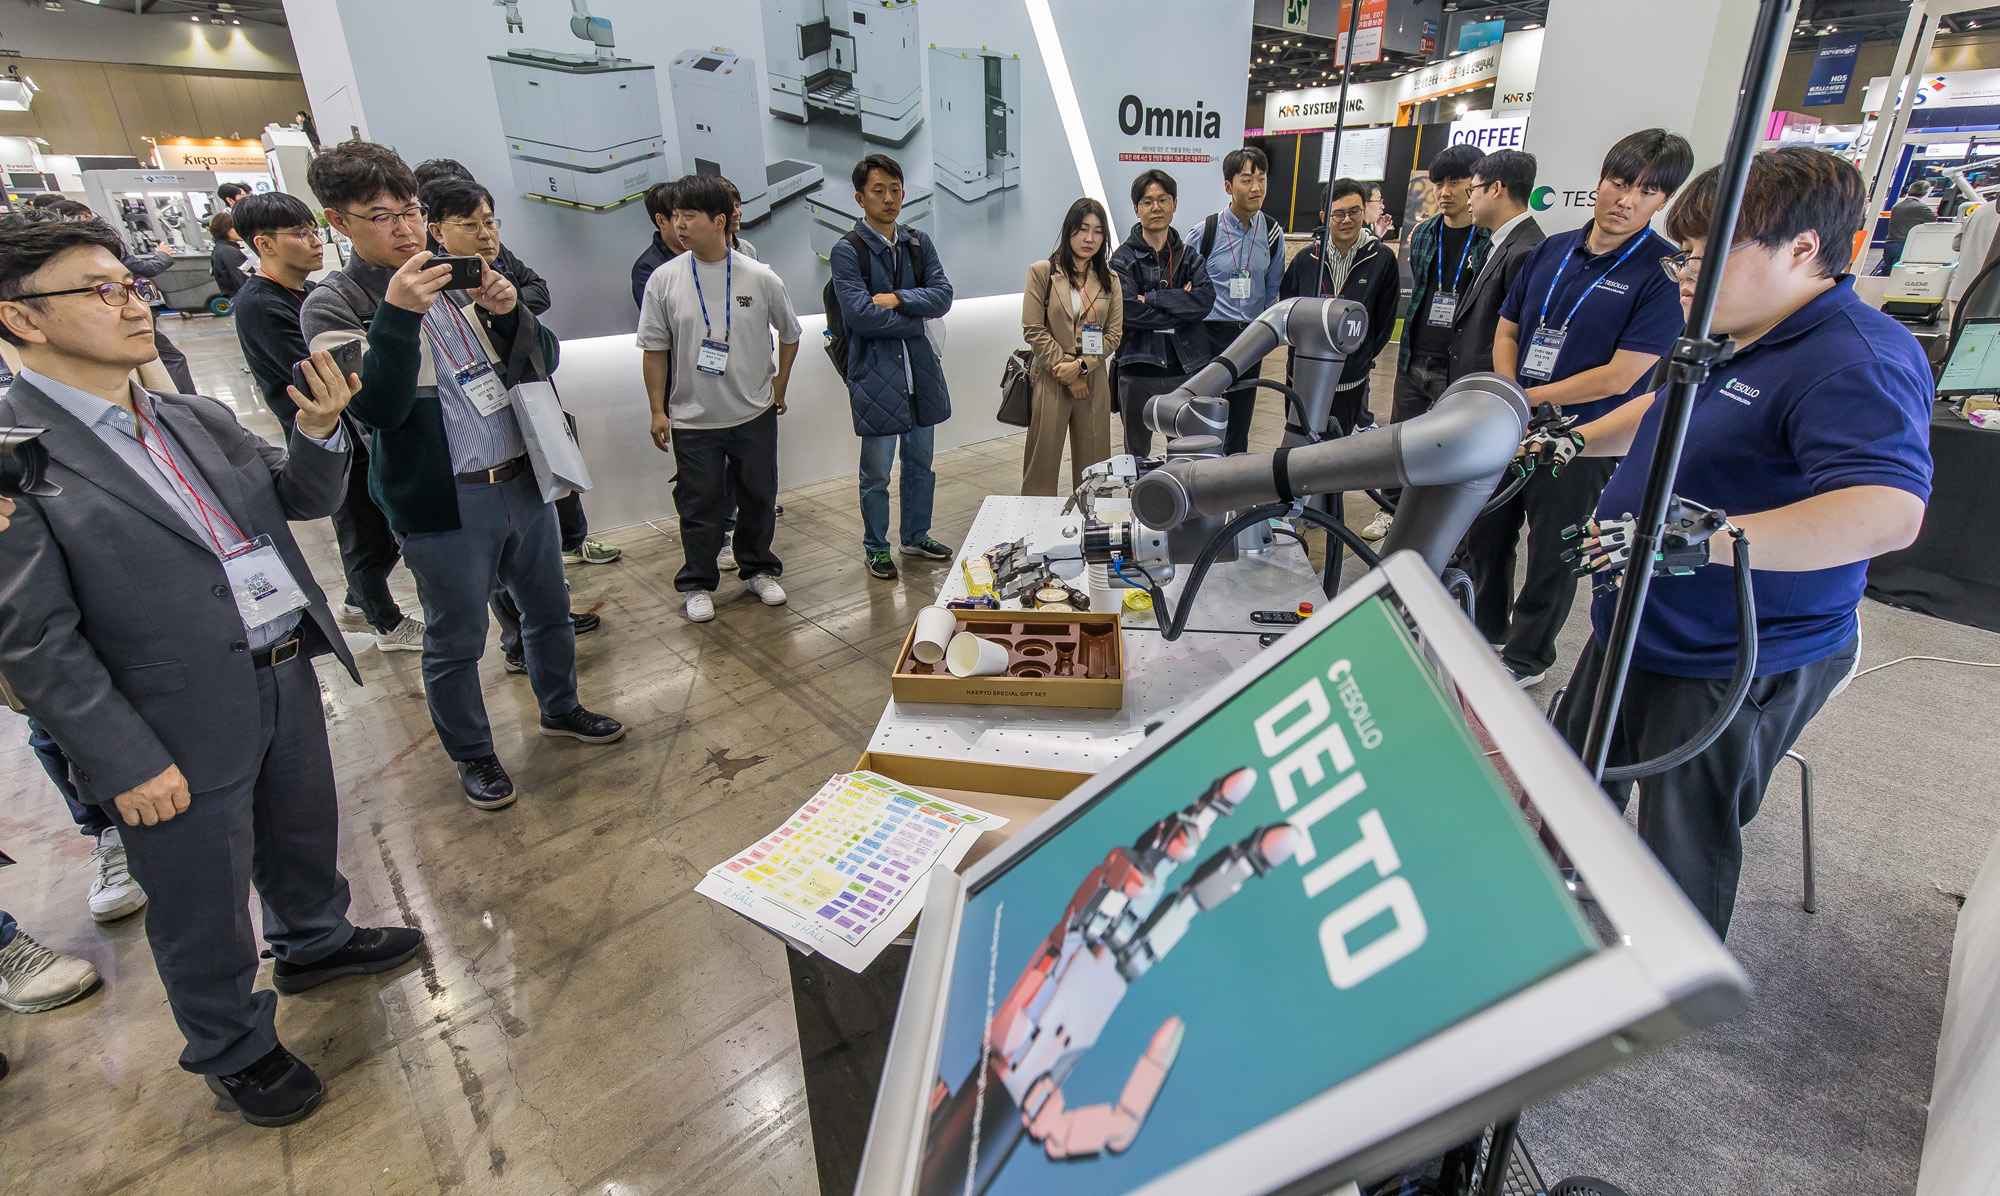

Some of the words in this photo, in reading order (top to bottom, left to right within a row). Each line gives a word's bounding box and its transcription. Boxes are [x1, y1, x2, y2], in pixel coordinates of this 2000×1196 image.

[1830, 74, 1848, 82] H05
[1279, 106, 1300, 118] KNR
[1303, 101, 1340, 116] SYSTEM
[1345, 98, 1364, 112] INC.
[1503, 92, 1524, 104] KNR
[1118, 94, 1221, 139] Omnia
[1452, 126, 1522, 149] COFFEE
[1562, 190, 1597, 207] TES
[1605, 279, 1629, 290] TESOLLO
[1732, 381, 1760, 398] TESOLLO
[1336, 671, 1384, 750] TESOLLO
[1253, 675, 1428, 991] DELTO
[722, 887, 732, 896] 2
[732, 889, 753, 908] HALL
[791, 921, 801, 930] 3
[800, 923, 825, 944] HALL
